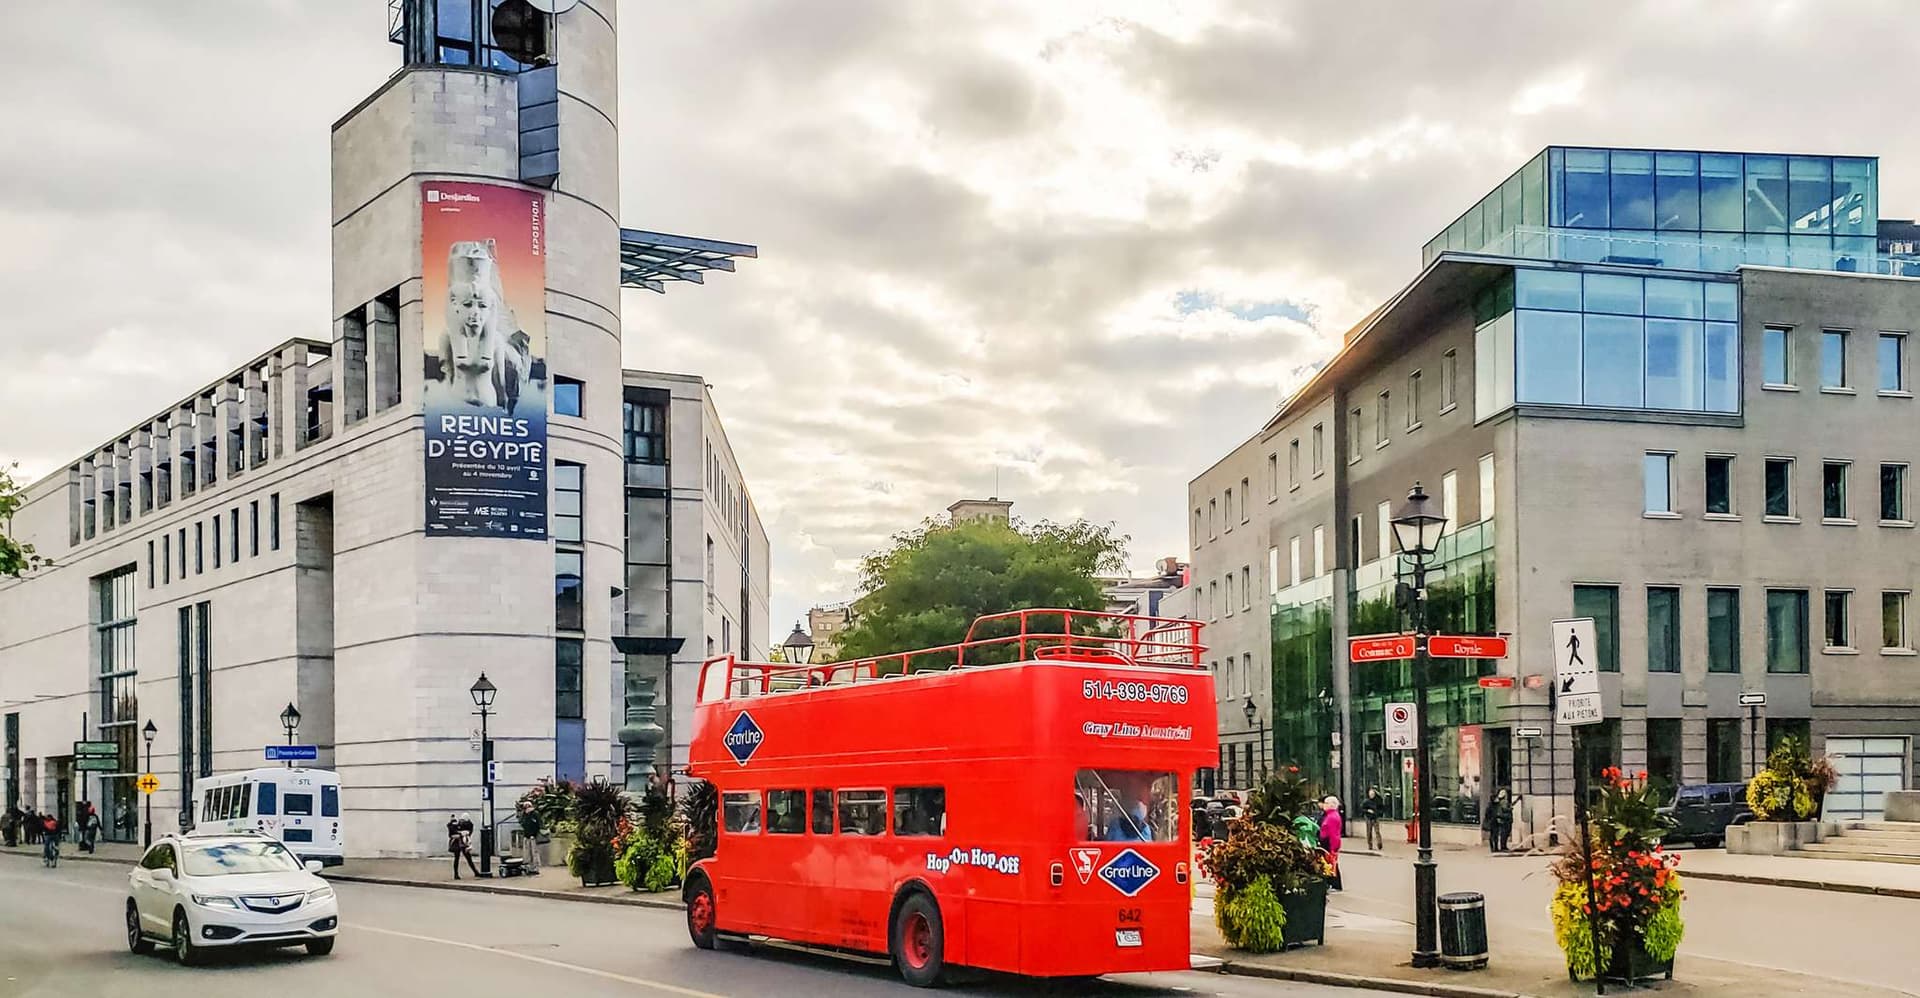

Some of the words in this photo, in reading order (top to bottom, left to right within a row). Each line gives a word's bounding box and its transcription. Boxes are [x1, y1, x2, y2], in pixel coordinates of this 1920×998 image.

[440, 192, 480, 203] Desjardins
[441, 415, 529, 437] REINES
[428, 435, 543, 463] D'ÉGYPTE
[487, 462, 497, 470] du
[1083, 680, 1188, 704] 514-398-9769
[1083, 722, 1112, 738] Gray
[1112, 723, 1140, 737] Line
[1141, 724, 1192, 740] Montréal
[1118, 908, 1142, 922] 642
